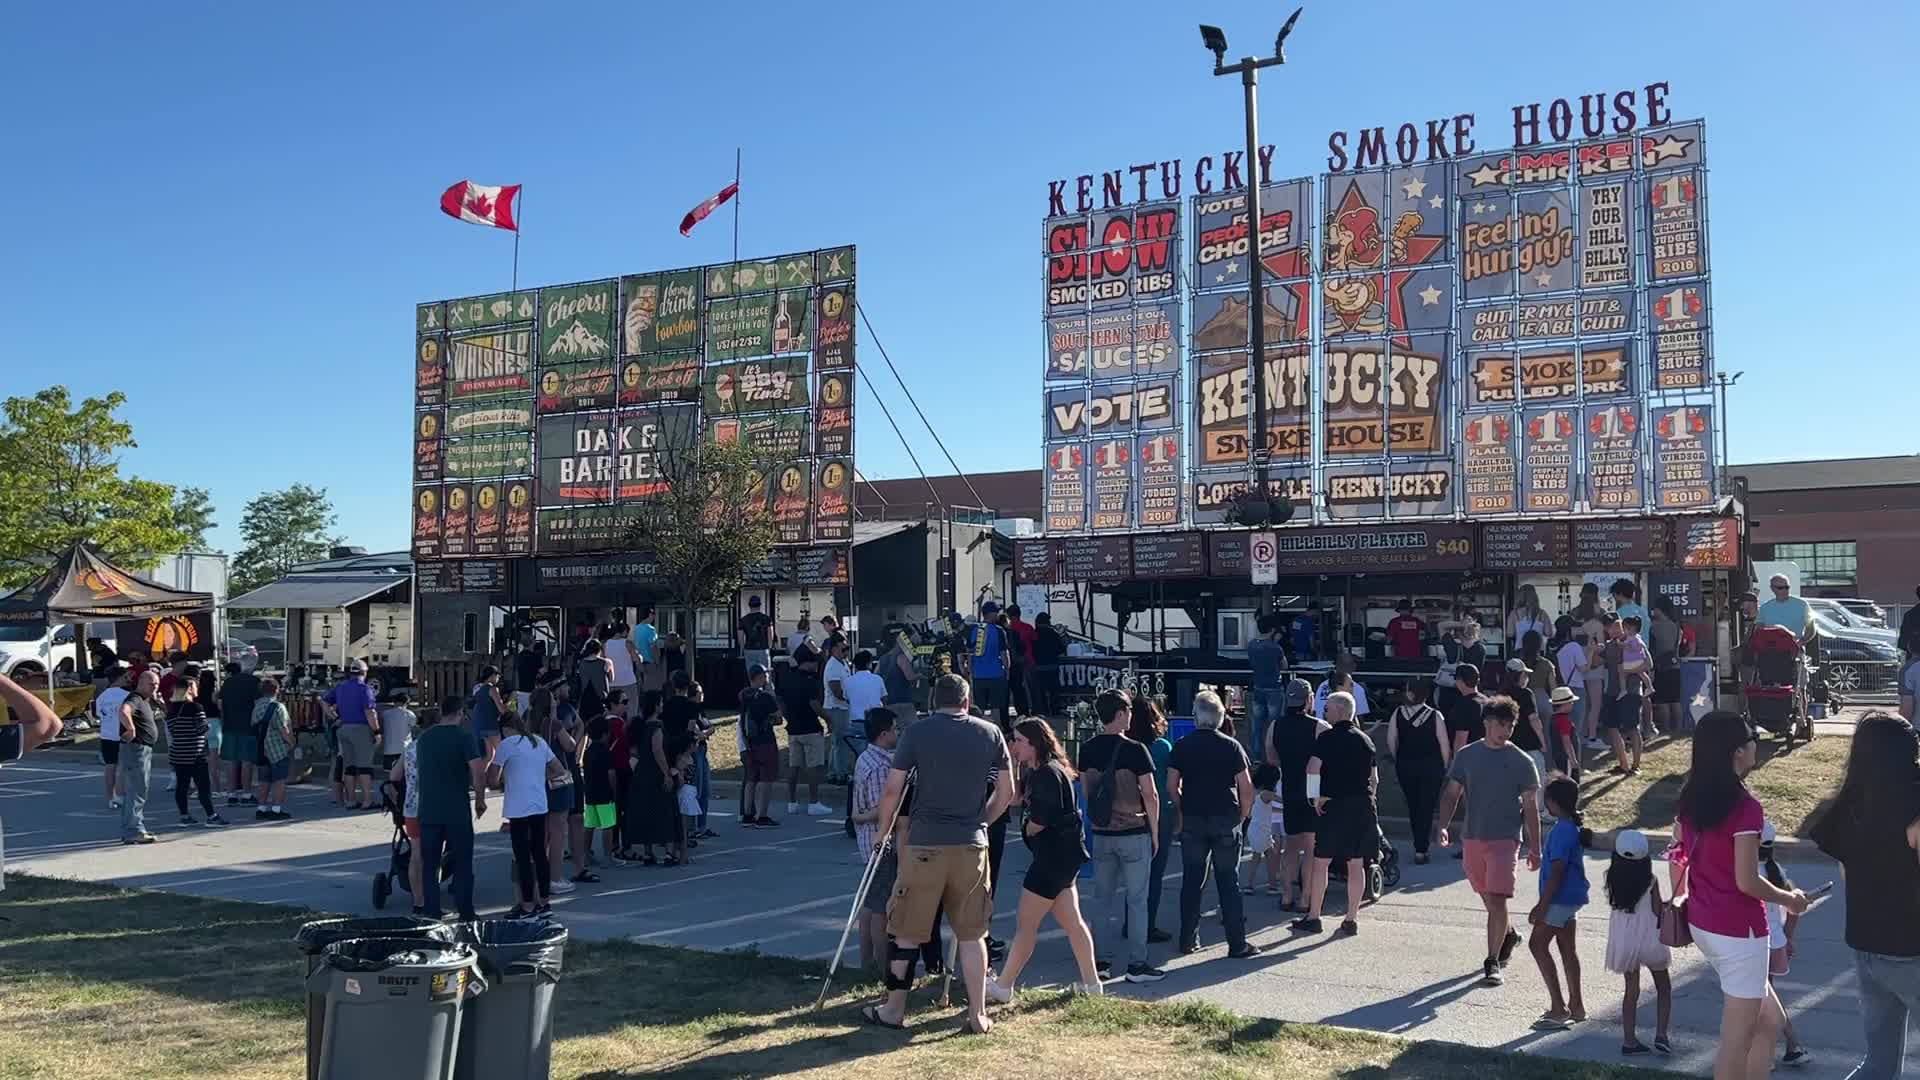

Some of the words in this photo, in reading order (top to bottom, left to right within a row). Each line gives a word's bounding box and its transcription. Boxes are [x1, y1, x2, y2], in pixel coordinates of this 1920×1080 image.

[1048, 144, 1277, 218] KENTUCKY
[1328, 112, 1476, 173] SMOKE
[1512, 80, 1671, 148] HOUSE
[1592, 186, 1621, 206] TRY
[1658, 175, 1692, 209] 1ST
[1197, 196, 1246, 216] VOTE
[1654, 208, 1694, 220] PLACE
[1592, 206, 1621, 226] OUR
[1200, 210, 1293, 246] PEOPE'S
[1464, 207, 1559, 252] Feeling
[1654, 220, 1699, 233] WELLAND
[1050, 209, 1176, 283] SLOW
[1199, 227, 1289, 264] CHOCE
[1588, 227, 1625, 246] HILL
[1654, 232, 1698, 245] JUDGED
[1464, 227, 1574, 281] Hungry?
[1584, 246, 1629, 267] BILLY
[1654, 242, 1698, 259] RIBS
[1584, 268, 1630, 283] PLATTER
[1050, 279, 1127, 305] SMOKED
[1135, 272, 1173, 294] RIBS
[547, 292, 608, 328] Cheers!
[659, 283, 696, 318] drink
[1663, 287, 1697, 321] 1ST
[746, 306, 769, 317] SAUCE
[1055, 319, 1086, 329] YOU'RE
[1091, 315, 1120, 327] ONNA
[1145, 310, 1166, 319] OUR
[1475, 306, 1538, 325] BUTER
[1540, 304, 1564, 319] MY
[1607, 299, 1621, 313] &
[656, 314, 697, 342] bourbon
[753, 319, 767, 329] YOU
[1472, 325, 1512, 342] CALL
[1537, 321, 1550, 337] A
[1551, 315, 1626, 336] BICUIT!
[1657, 321, 1698, 331] PLACE
[740, 335, 762, 347] 2/$12
[1053, 327, 1122, 352] SOUTERN
[1657, 332, 1703, 345] TORONTO
[454, 342, 528, 382] WHISKEY
[1059, 341, 1168, 372] SAUCES
[1657, 355, 1702, 370] SAUCE
[646, 371, 673, 388] Cook
[675, 368, 695, 386] off
[744, 364, 761, 375] It's
[1500, 359, 1607, 382] SMOKED
[487, 378, 518, 388] QUALITY
[740, 371, 787, 389] BBQ
[1201, 352, 1439, 427] KENTUCKY
[744, 380, 793, 402] Time!
[1479, 384, 1560, 400] PULLED
[1563, 381, 1626, 395] PORK
[1053, 386, 1168, 432] VOTE
[1474, 414, 1505, 446] 1ST
[1536, 410, 1569, 442] 1ST
[1598, 406, 1631, 438] 1ST
[1665, 407, 1700, 440] 1ST
[576, 424, 633, 453] OAK
[1326, 422, 1425, 448] HOUSE
[1593, 440, 1633, 449] PLACE
[1469, 447, 1507, 456] PLACE
[1530, 444, 1569, 453] PLACE
[1661, 441, 1702, 450] PLACE
[1467, 457, 1512, 467] HAMILTON
[1528, 455, 1571, 465] ORILLIA
[1588, 449, 1640, 462] WATERLOO
[1659, 451, 1706, 463] WINDSOR
[560, 452, 664, 484] BARREL
[1096, 469, 1126, 477] PLACE
[1143, 464, 1174, 473] PLACE
[1491, 464, 1514, 473] PARK
[1591, 464, 1636, 476] JUDGED
[1666, 470, 1703, 480] RIBS
[1331, 472, 1446, 499] KENTUCKY
[1532, 479, 1568, 489] RIBS
[1594, 475, 1633, 487] SAUCE
[1142, 487, 1177, 498] JUDGED
[1145, 498, 1174, 508] SAUCE
[1280, 536, 1357, 552] HILLBILLY
[1360, 532, 1427, 548] PLATTER
[1436, 538, 1470, 556] $40
[541, 567, 558, 577] THE
[560, 562, 623, 577] LUMBERJACK
[1659, 583, 1690, 595] BEEF
[378, 975, 420, 985] BRUTE
